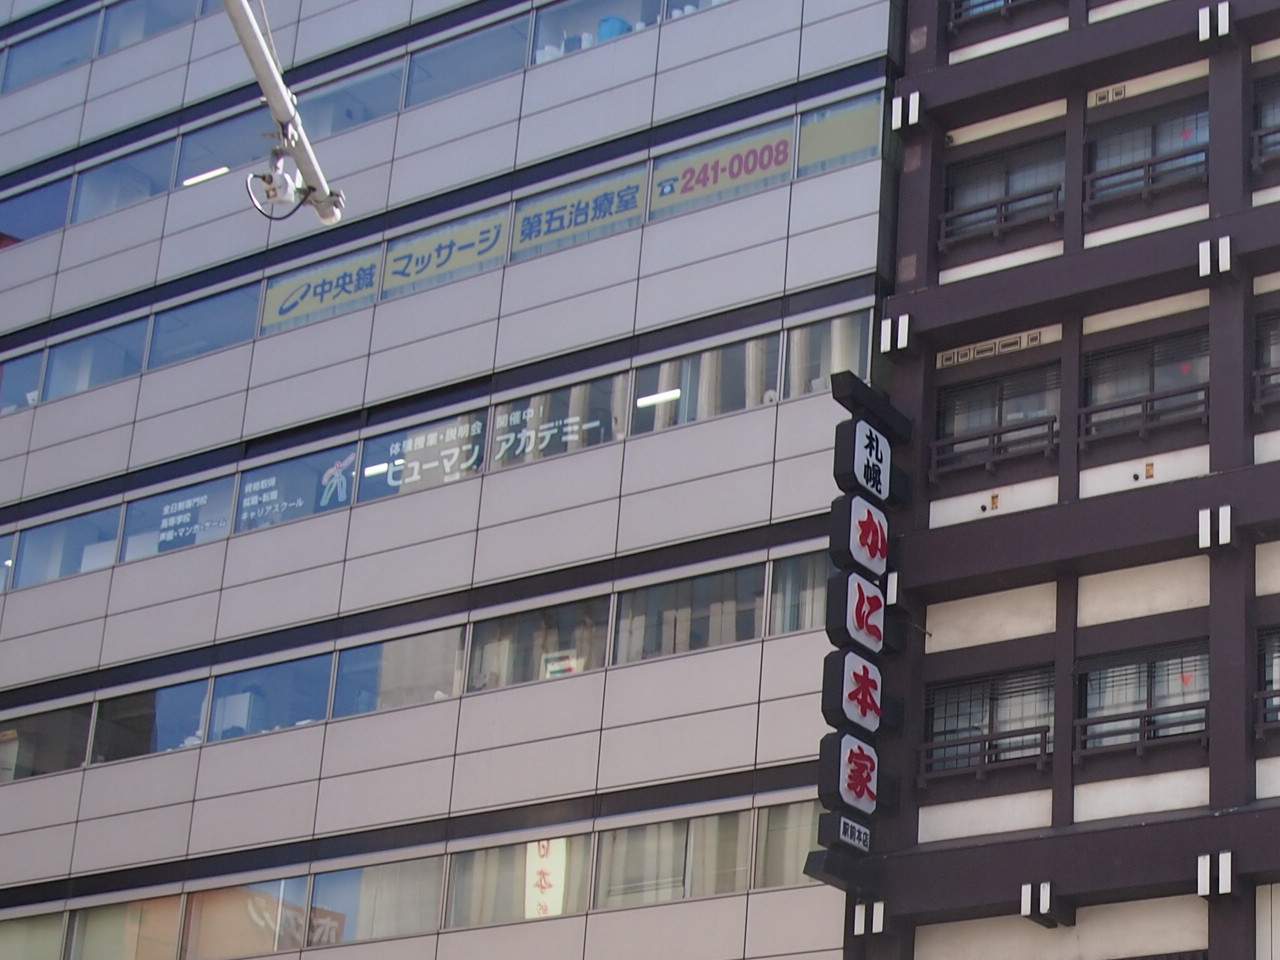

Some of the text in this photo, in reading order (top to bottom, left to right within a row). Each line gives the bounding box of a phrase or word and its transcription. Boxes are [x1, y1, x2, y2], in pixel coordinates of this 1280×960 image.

[392, 224, 501, 278] マッサージ
[519, 184, 640, 242] 第五治療室
[680, 139, 790, 194] 241-0008
[494, 416, 600, 461] アカデミー
[863, 428, 884, 495] 札幌
[241, 498, 304, 520] キャリアスクール
[846, 508, 888, 802] かに本家
[841, 821, 870, 850] 駅前本店
